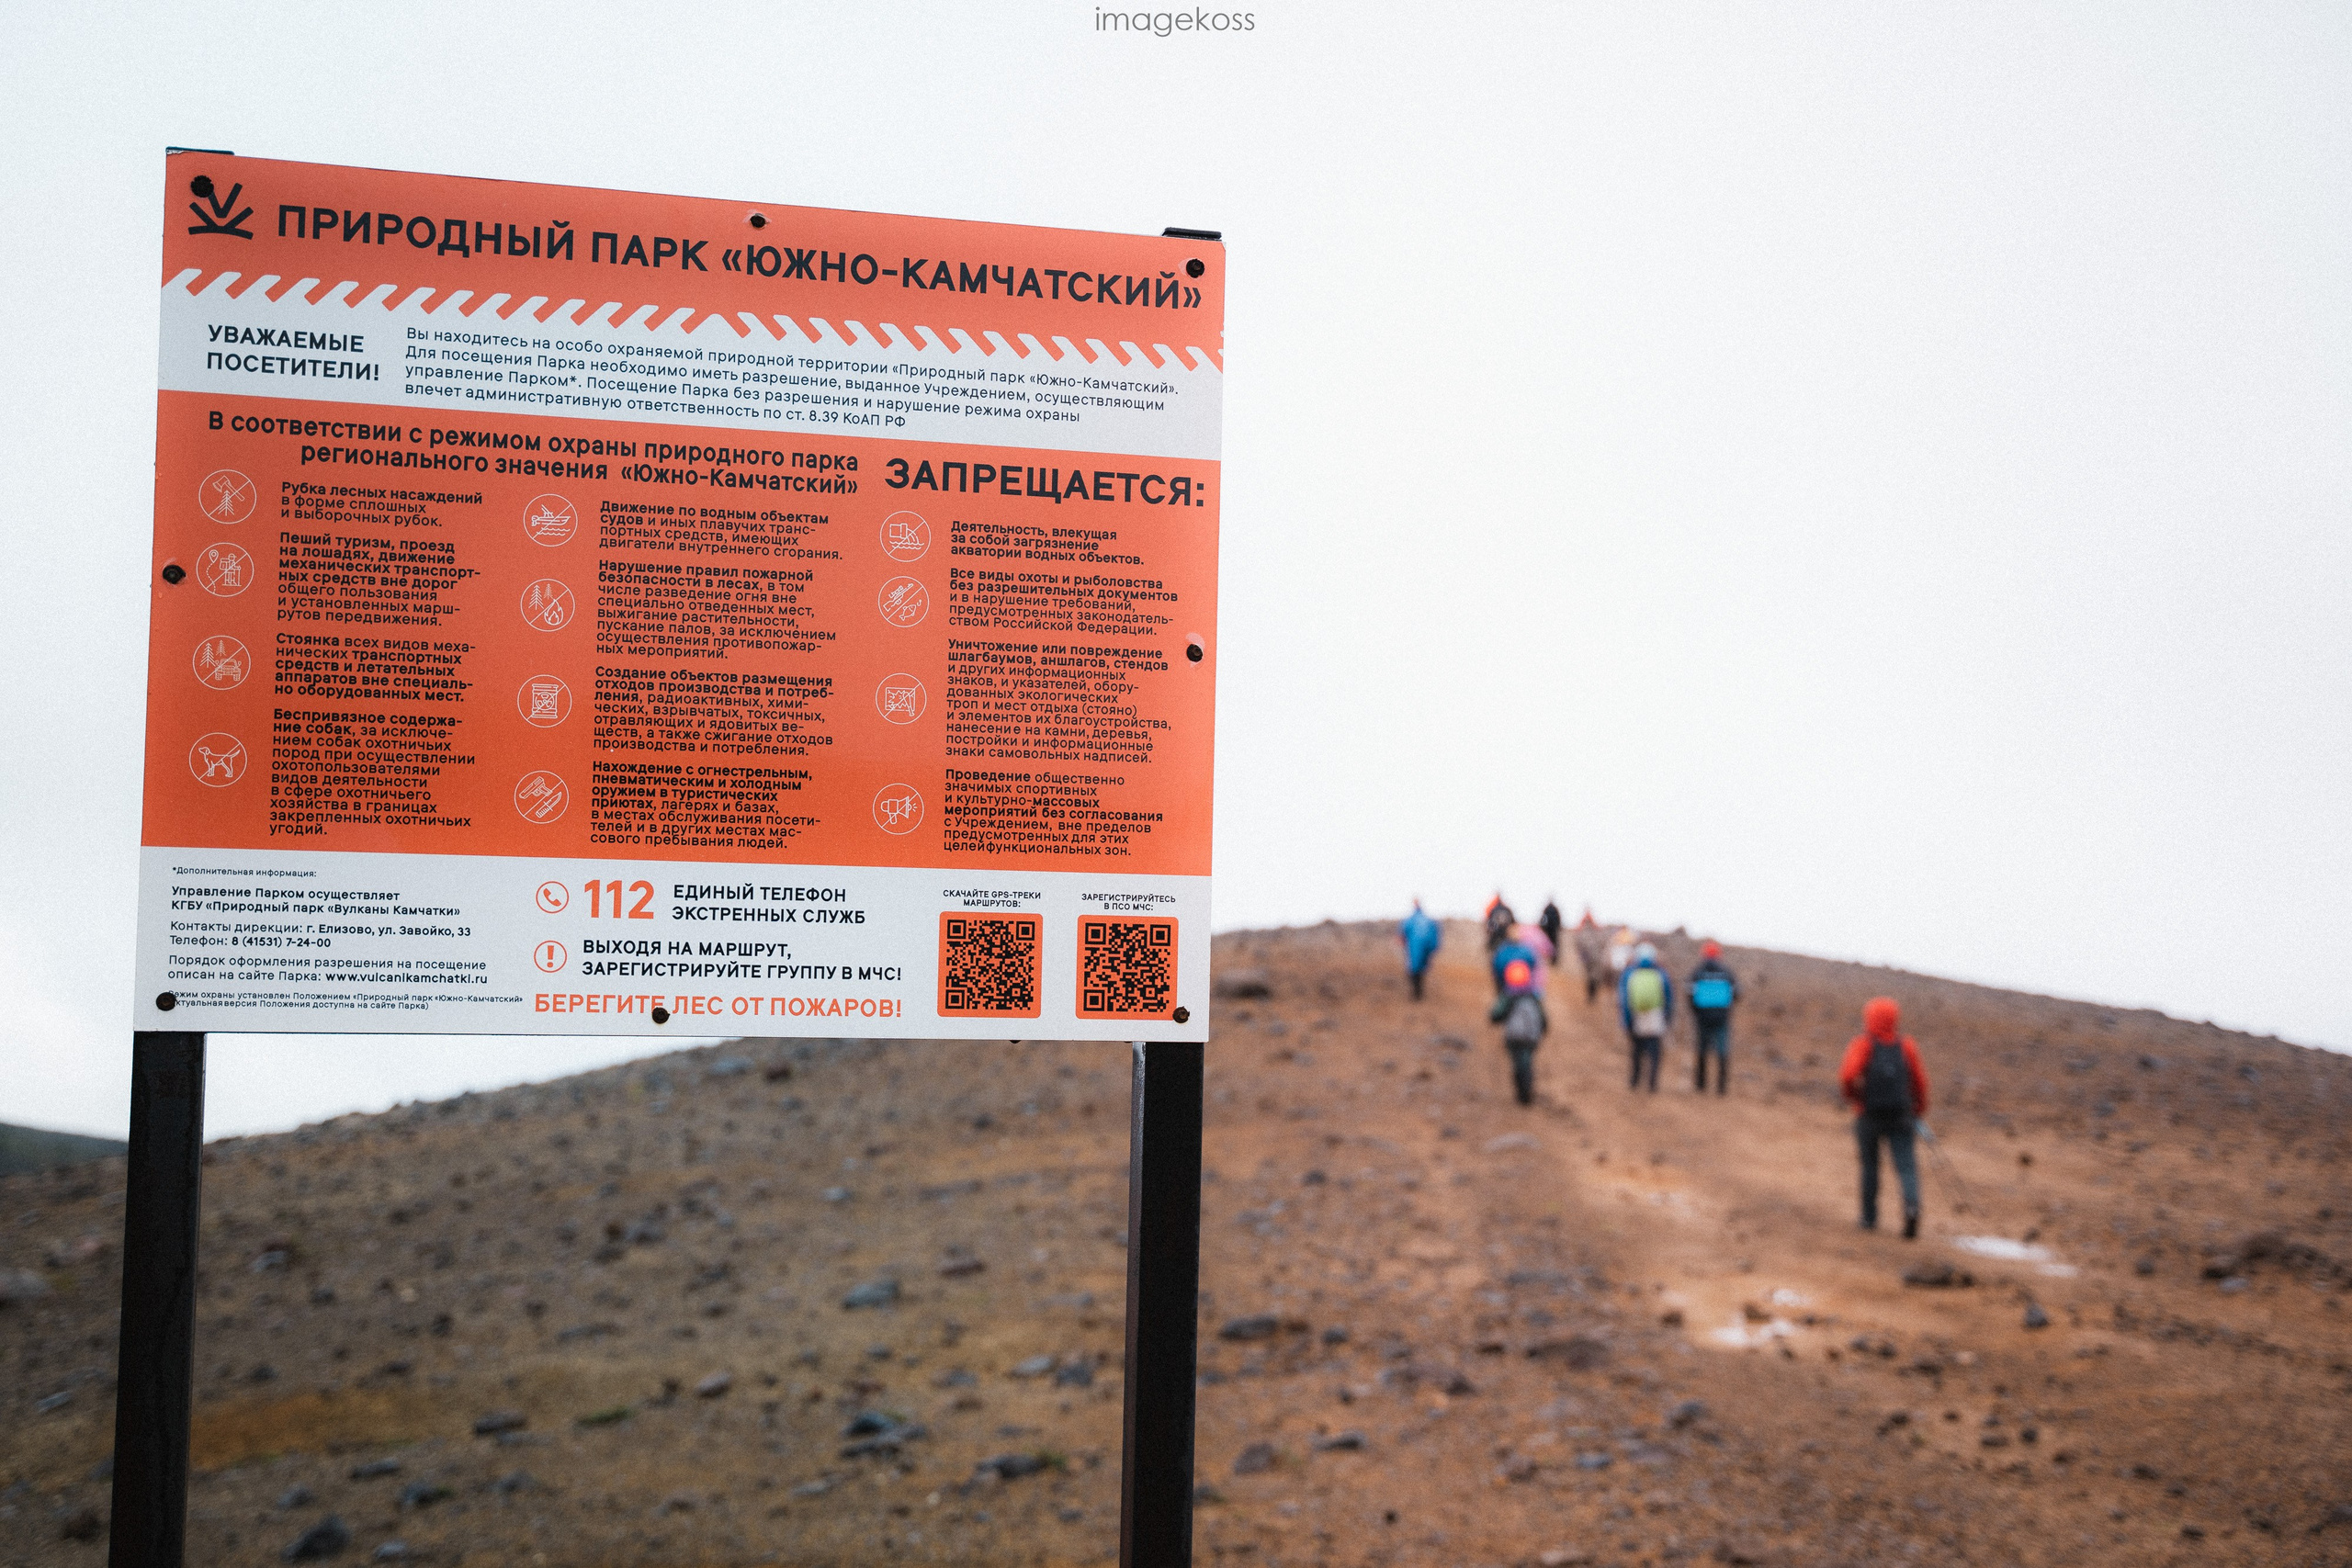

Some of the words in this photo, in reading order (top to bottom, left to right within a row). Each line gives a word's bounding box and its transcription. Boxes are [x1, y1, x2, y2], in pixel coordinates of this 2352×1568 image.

[277, 205, 574, 260] ПРИРОДНЫЙ
[591, 231, 708, 271] ПАРК
[721, 246, 1203, 309] «ЮЖНО-КАМЧАТСКИЙ»
[208, 324, 364, 353] УВАЖАЕМЫЕ
[207, 352, 379, 380] ПОСЕТИТЕЛИ!
[406, 326, 429, 340] Вы
[434, 331, 528, 347] находитесь
[531, 338, 550, 349] на
[555, 339, 603, 353] особо
[606, 344, 703, 360] охраняемой
[707, 351, 794, 367] природной
[797, 357, 888, 374] территории
[892, 363, 985, 380] «Природный
[989, 371, 1025, 385] парк
[1029, 373, 1178, 393] «Южно-Камчатский».
[404, 344, 435, 359] Для
[441, 349, 532, 366] посещения
[537, 354, 585, 370] Парка
[590, 360, 687, 377] необходимо
[692, 368, 739, 381] иметь
[741, 371, 841, 389] разрешение,
[845, 378, 921, 393] выданное
[923, 383, 1030, 401] Учреждением,
[1035, 392, 1164, 411] осуществляющим
[405, 366, 503, 382] управление
[586, 376, 677, 394] Посещение
[681, 383, 729, 399] Парка
[733, 386, 760, 400] без
[764, 390, 858, 406] разрешения
[863, 398, 872, 408] и
[876, 399, 960, 413] нарушение
[965, 404, 1021, 418] режима
[1025, 409, 1080, 422] охраны
[209, 410, 223, 430] В
[230, 415, 401, 441] соответствии
[408, 427, 423, 444] с
[429, 428, 540, 450] режимом
[548, 436, 637, 457] охраны
[644, 443, 785, 466] природного
[791, 452, 858, 473] парка
[300, 445, 489, 471] регионального
[494, 457, 607, 479] значения
[621, 464, 857, 493] «Южно-Камчатский»
[884, 458, 1204, 505] ЗАПРЕЩАЕТСЯ:
[281, 480, 326, 496] Рубка
[329, 486, 387, 499] лесных
[390, 490, 482, 504] насаждений
[280, 495, 290, 505] в
[294, 495, 345, 509] форме
[348, 500, 426, 513] сплошных
[599, 500, 674, 515] Движение
[678, 506, 696, 516] по
[699, 507, 756, 520] водным
[760, 510, 829, 524] объектам
[950, 520, 1048, 537] Деятельность,
[1051, 527, 1117, 541] влекущая
[279, 531, 332, 546] Пеший
[334, 536, 395, 550] туризм,
[399, 539, 455, 554] проезд
[279, 546, 298, 557] на
[300, 547, 374, 561] лошадях,
[378, 551, 455, 564] движение
[598, 559, 683, 574] Нарушение
[685, 565, 739, 577] правил
[742, 569, 813, 581] пожарной
[949, 567, 975, 580] Все
[978, 570, 1014, 582] виды
[1017, 572, 1058, 583] охоты
[1061, 575, 1069, 584] и
[1073, 574, 1163, 589] рыболовства
[276, 632, 340, 647] Стоянка
[344, 637, 379, 648] всех
[383, 638, 429, 651] видов
[433, 641, 475, 652] меха-
[947, 638, 1038, 653] Уничтожение
[1042, 644, 1067, 654] или
[1069, 646, 1163, 659] повреждение
[594, 665, 667, 680] Создание
[670, 669, 738, 682] объектов
[741, 673, 832, 687] размещения
[273, 707, 386, 724] Беспривязное
[389, 714, 462, 728] содержа-
[592, 761, 683, 775] Нахождение
[684, 765, 694, 775] с
[697, 766, 812, 780] огнестрельным,
[944, 768, 1031, 783] Проведение
[1034, 772, 1125, 785] общественно
[254, 869, 317, 877] информация:
[171, 886, 251, 897] Управление
[254, 887, 304, 899] Парком
[308, 890, 400, 901] осуществляет
[583, 879, 654, 919] 112
[673, 883, 753, 901] ЕДИНЫЙ
[759, 886, 845, 902] ТЕЛЕФОН
[942, 888, 989, 898] СКАЧАЙТЕ
[990, 890, 1041, 899] GPS-ТРЕКИ
[1080, 893, 1176, 903] ЗАРЕГИСТРИРУЙТЕСЬ
[171, 899, 203, 910] КГБУ
[205, 900, 289, 913] «Природный
[292, 904, 324, 915] парк
[327, 903, 389, 916] «Вулканы
[392, 905, 460, 916] Камчатки»
[963, 898, 1021, 908] МАРШРУТОВ:
[1103, 901, 1110, 910] В
[1112, 902, 1130, 910] ПСО
[1132, 903, 1153, 911] МЧС:
[672, 906, 797, 922] ЭКСТРЕННЫХ
[802, 908, 865, 924] СЛУЖБ
[170, 920, 232, 931] Контакты
[233, 923, 302, 933] дирекции:
[306, 924, 315, 933] г.
[318, 923, 375, 936] Елизово,
[378, 926, 396, 937] ул.
[399, 925, 455, 937] Завойко,
[457, 926, 470, 937] 33
[169, 934, 228, 947] Телефон:
[231, 936, 239, 946] 8
[242, 935, 282, 948] (41531)
[286, 937, 331, 948] 7-24-00
[582, 939, 662, 956] ВЫХОДЯ
[667, 941, 693, 955] НА
[698, 942, 791, 959] МАРШРУТ,
[168, 954, 225, 966] Порядок
[228, 956, 311, 967] оформления
[313, 958, 393, 969] разрешения
[396, 960, 412, 969] на
[415, 960, 486, 970] посещение
[582, 961, 762, 978] ЗАРЕГИСТРИРУЙТЕ
[767, 964, 837, 979] ГРУППУ
[842, 965, 853, 980] В
[858, 966, 901, 981] МЧС!
[167, 970, 215, 979] описан
[219, 971, 234, 980] на
[237, 969, 275, 980] сайте
[277, 970, 321, 982] Парка:
[324, 972, 488, 984] www.vulcanikamchatki.ru
[199, 991, 235, 999] охраны
[237, 992, 290, 1000] установлен
[292, 991, 351, 1000] Положением
[352, 992, 409, 1001] «Природный
[435, 995, 524, 1004] «Южно-Камчатский»
[535, 993, 666, 1014] БЕРЕГИТЕ
[672, 995, 724, 1016] ЛЕС
[731, 996, 764, 1015] ОТ
[770, 997, 901, 1017] ПОЖАРОВ!
